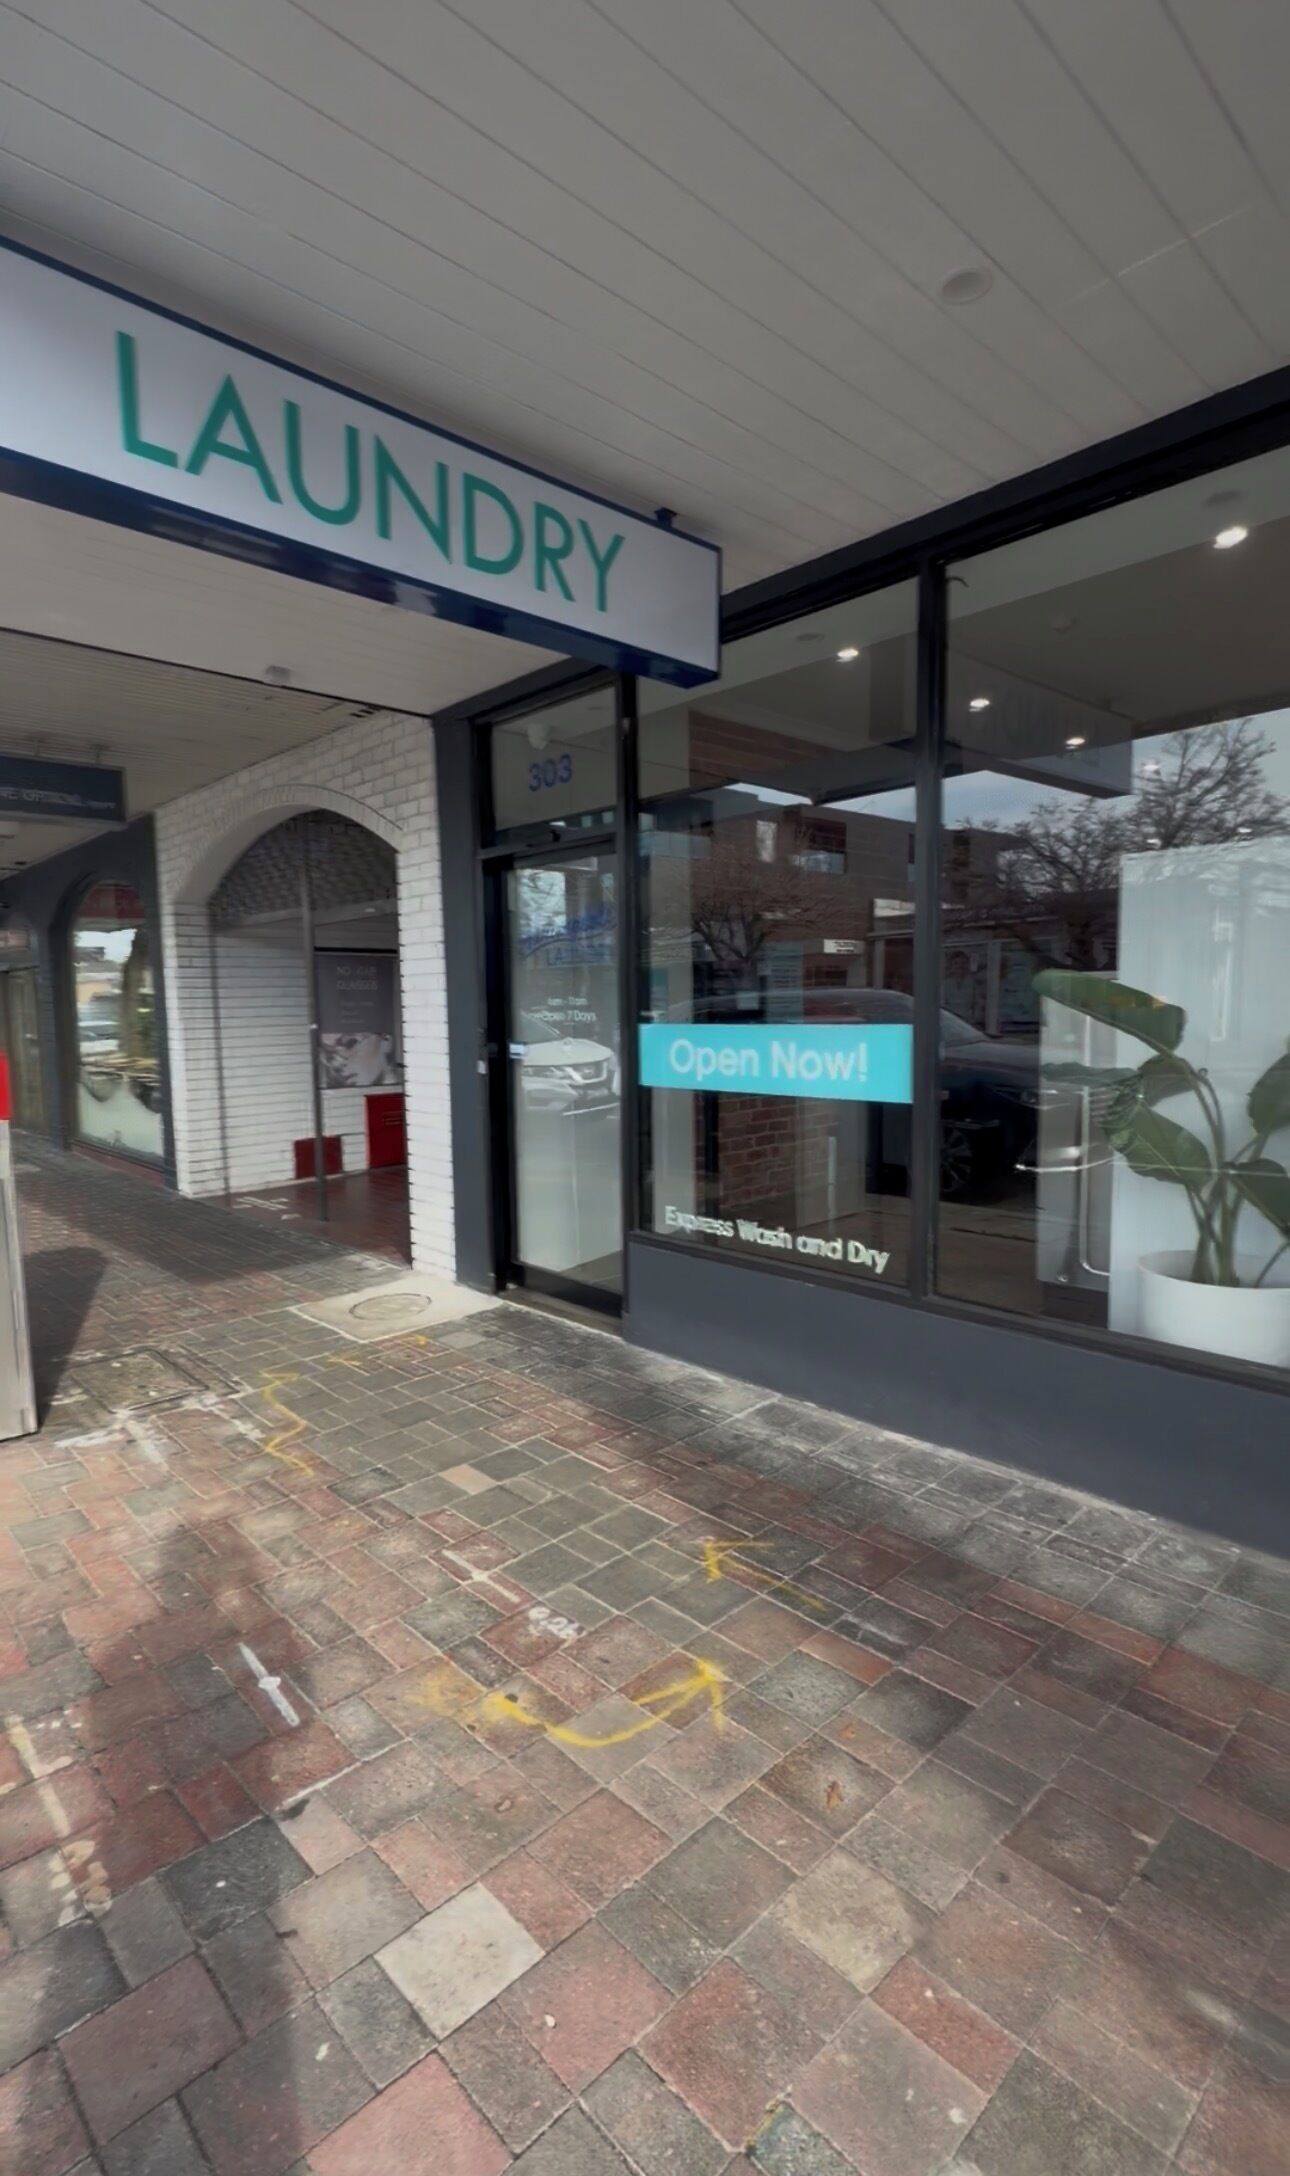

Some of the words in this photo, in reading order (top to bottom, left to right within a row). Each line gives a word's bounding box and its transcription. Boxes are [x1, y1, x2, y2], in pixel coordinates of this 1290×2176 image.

[115, 330, 626, 613] LAUNDRY
[528, 752, 572, 792] 303
[574, 1010, 597, 1023] Days
[669, 1038, 760, 1081] Open
[771, 1040, 868, 1082] Now!
[664, 1205, 734, 1239] Express
[736, 1218, 792, 1249] Wash
[796, 1236, 843, 1260] and
[847, 1239, 891, 1275] Dry
